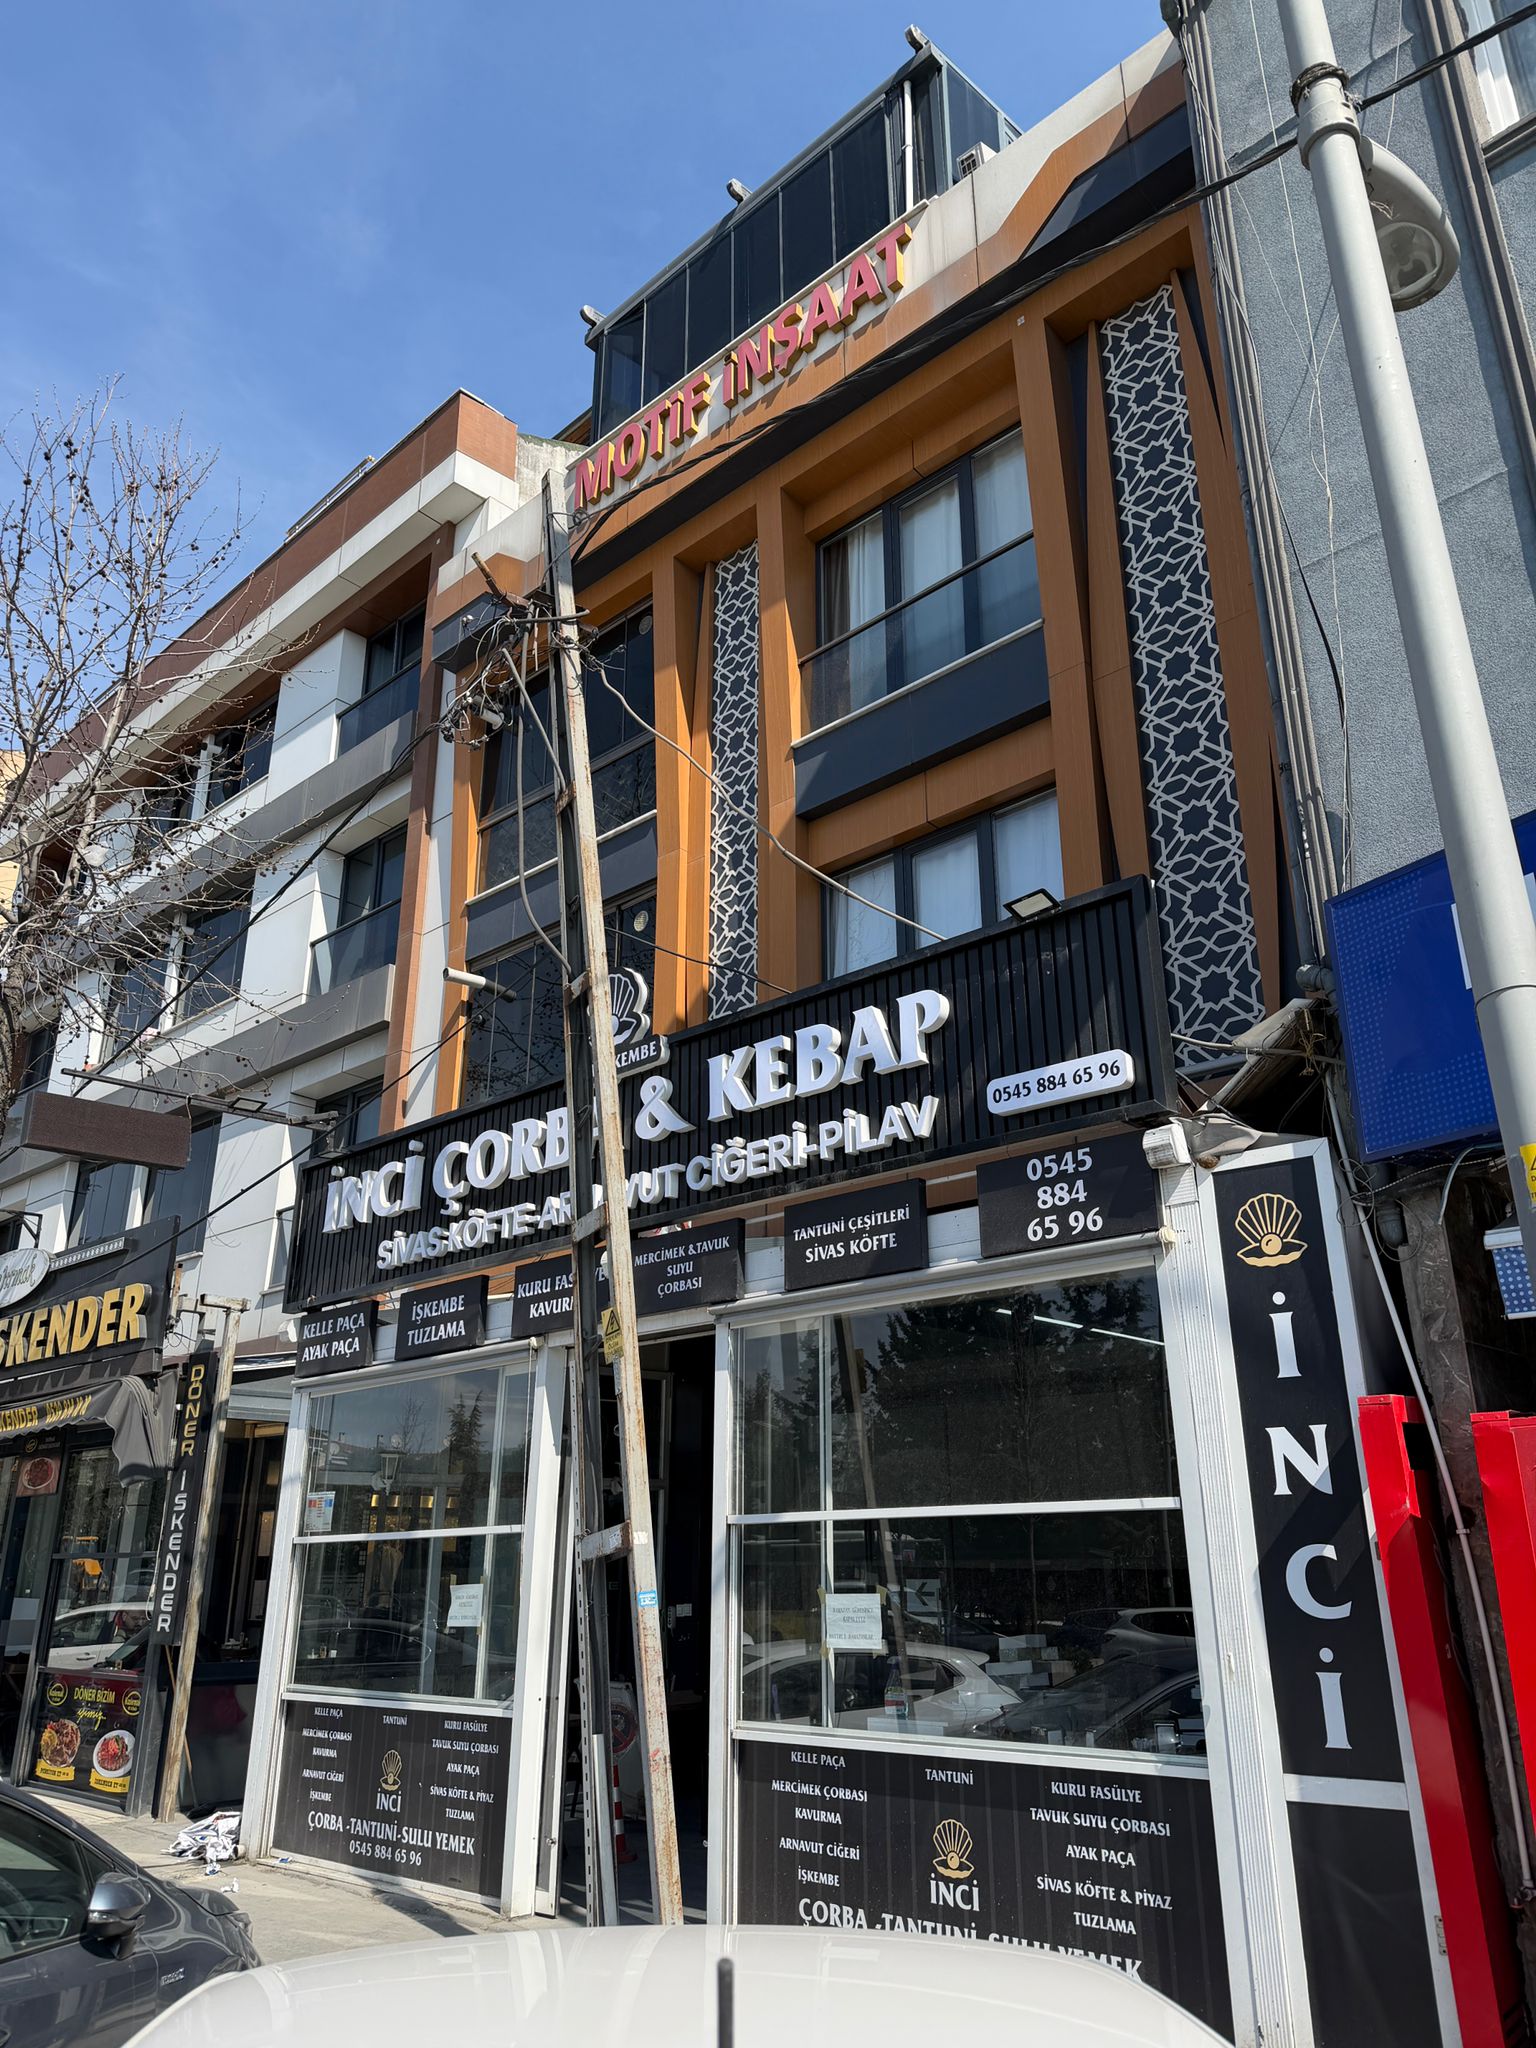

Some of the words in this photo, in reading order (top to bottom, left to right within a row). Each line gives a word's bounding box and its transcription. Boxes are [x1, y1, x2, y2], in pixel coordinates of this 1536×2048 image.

[574, 372, 711, 512] MOTİF
[722, 223, 912, 409] İNŞAAT
[992, 1081, 1032, 1104] 0545
[1036, 1072, 1067, 1094] 884
[1072, 1066, 1093, 1085] 65
[1098, 1059, 1121, 1079] 96
[322, 1140, 426, 1234] İNCİ
[634, 1075, 697, 1142] &
[707, 989, 950, 1122] KEBAP
[1027, 1147, 1093, 1181] 0545
[1037, 1179, 1087, 1209] 884
[793, 1216, 845, 1241] TANTUNİ
[848, 1204, 910, 1232] ÇEŞİTLERİ
[1027, 1215, 1060, 1242] 65
[1068, 1207, 1103, 1235] 96
[634, 1245, 685, 1267] MERCİMEK
[805, 1241, 845, 1263] SİVAS
[849, 1232, 898, 1256] KÖFTE
[666, 1261, 693, 1277] SUYU
[517, 1278, 551, 1298] KURU
[657, 1276, 702, 1299] ÇORBASI
[411, 1295, 465, 1322] İŞKEMBE
[529, 1296, 574, 1318] KAVUR
[303, 1318, 333, 1340] KELLE
[336, 1312, 365, 1334] PAÇA
[407, 1320, 465, 1346] TUZLAMA
[302, 1343, 328, 1362] AYAK
[331, 1337, 360, 1358] PAÇA
[181, 1364, 205, 1456] DÖNER
[1265, 1291, 1352, 1749] İNCİ
[74, 1685, 96, 1703] DÖNER
[314, 1707, 329, 1717] KELLE
[330, 1709, 343, 1719] PAÇA
[383, 1715, 407, 1726] TANTUNİ
[302, 1727, 328, 1739] MERCİMEK
[329, 1731, 352, 1741] ÇORBASI
[444, 1720, 461, 1731] KURU
[312, 1747, 337, 1758] KAVURMA
[432, 1739, 451, 1749] TAVUK
[453, 1741, 469, 1751] SUYU
[471, 1743, 499, 1754] ÇORBASI
[446, 1763, 462, 1773] AYAK
[463, 1764, 480, 1777] PAÇA
[791, 1751, 818, 1764] KELLE
[821, 1754, 846, 1770] PAÇA
[302, 1768, 325, 1780] ARNAVUT
[326, 1769, 344, 1782] CİĞERİ
[925, 1768, 974, 1786] TANTUNİ
[309, 1788, 332, 1801] İŞKEMBE
[376, 1788, 401, 1812] İNCİ
[430, 1784, 447, 1797] SİVAS
[448, 1786, 468, 1800] KÖFTE
[469, 1791, 475, 1800] &
[476, 1790, 494, 1803] PİYAZ
[772, 1780, 821, 1797] MERCİMEK
[823, 1786, 868, 1802] ÇORBASI
[1051, 1781, 1086, 1797] KURU
[1090, 1784, 1142, 1803] FASÜLYE
[446, 1808, 475, 1821] TUZLAMA
[795, 1807, 842, 1825] KAVURMA
[1030, 1807, 1071, 1825] TAVUK
[1073, 1812, 1107, 1829] SUYU
[1110, 1817, 1171, 1837] ÇORBASI
[308, 1811, 343, 1832] ÇORBA
[436, 1831, 475, 1856] YEMEK
[350, 1840, 372, 1856] 0545
[375, 1845, 392, 1860] 884
[394, 1849, 407, 1864] 65
[409, 1852, 422, 1866] 96
[779, 1837, 824, 1854] ARNAVUT
[826, 1842, 860, 1860] CİĞERİ
[1066, 1844, 1098, 1861] AYAK
[1101, 1848, 1136, 1869] PAÇA
[798, 1865, 840, 1887] İŞKEMBE
[929, 1872, 980, 1911] İNCİ
[1037, 1874, 1071, 1894] SİVAS
[1075, 1880, 1116, 1901] KÖFTE
[1120, 1889, 1132, 1904] &
[1135, 1889, 1173, 1910] PİYAZ
[799, 1898, 868, 1929] ÇORBA
[1073, 1911, 1136, 1935] TUZLAMA
